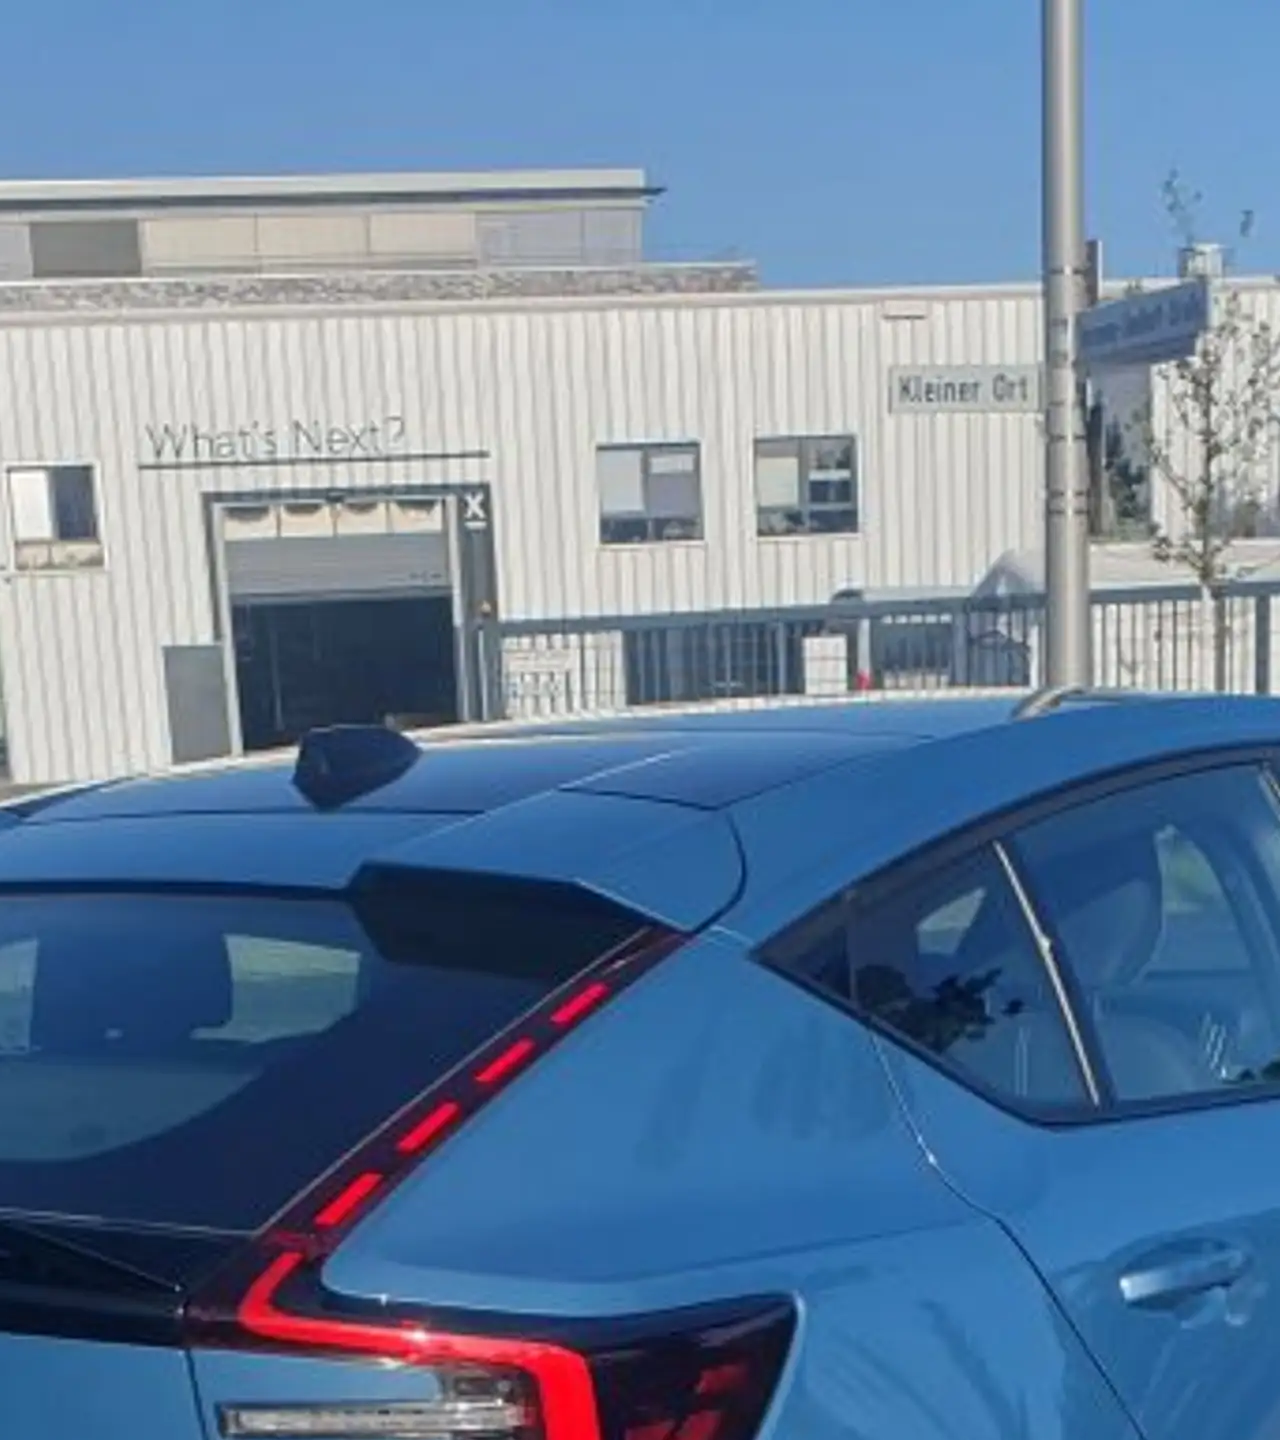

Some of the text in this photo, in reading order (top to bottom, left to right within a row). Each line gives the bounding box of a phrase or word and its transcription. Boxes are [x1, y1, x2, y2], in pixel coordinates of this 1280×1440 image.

[898, 375, 981, 402] Kleiner
[144, 415, 405, 461] What's Next?
